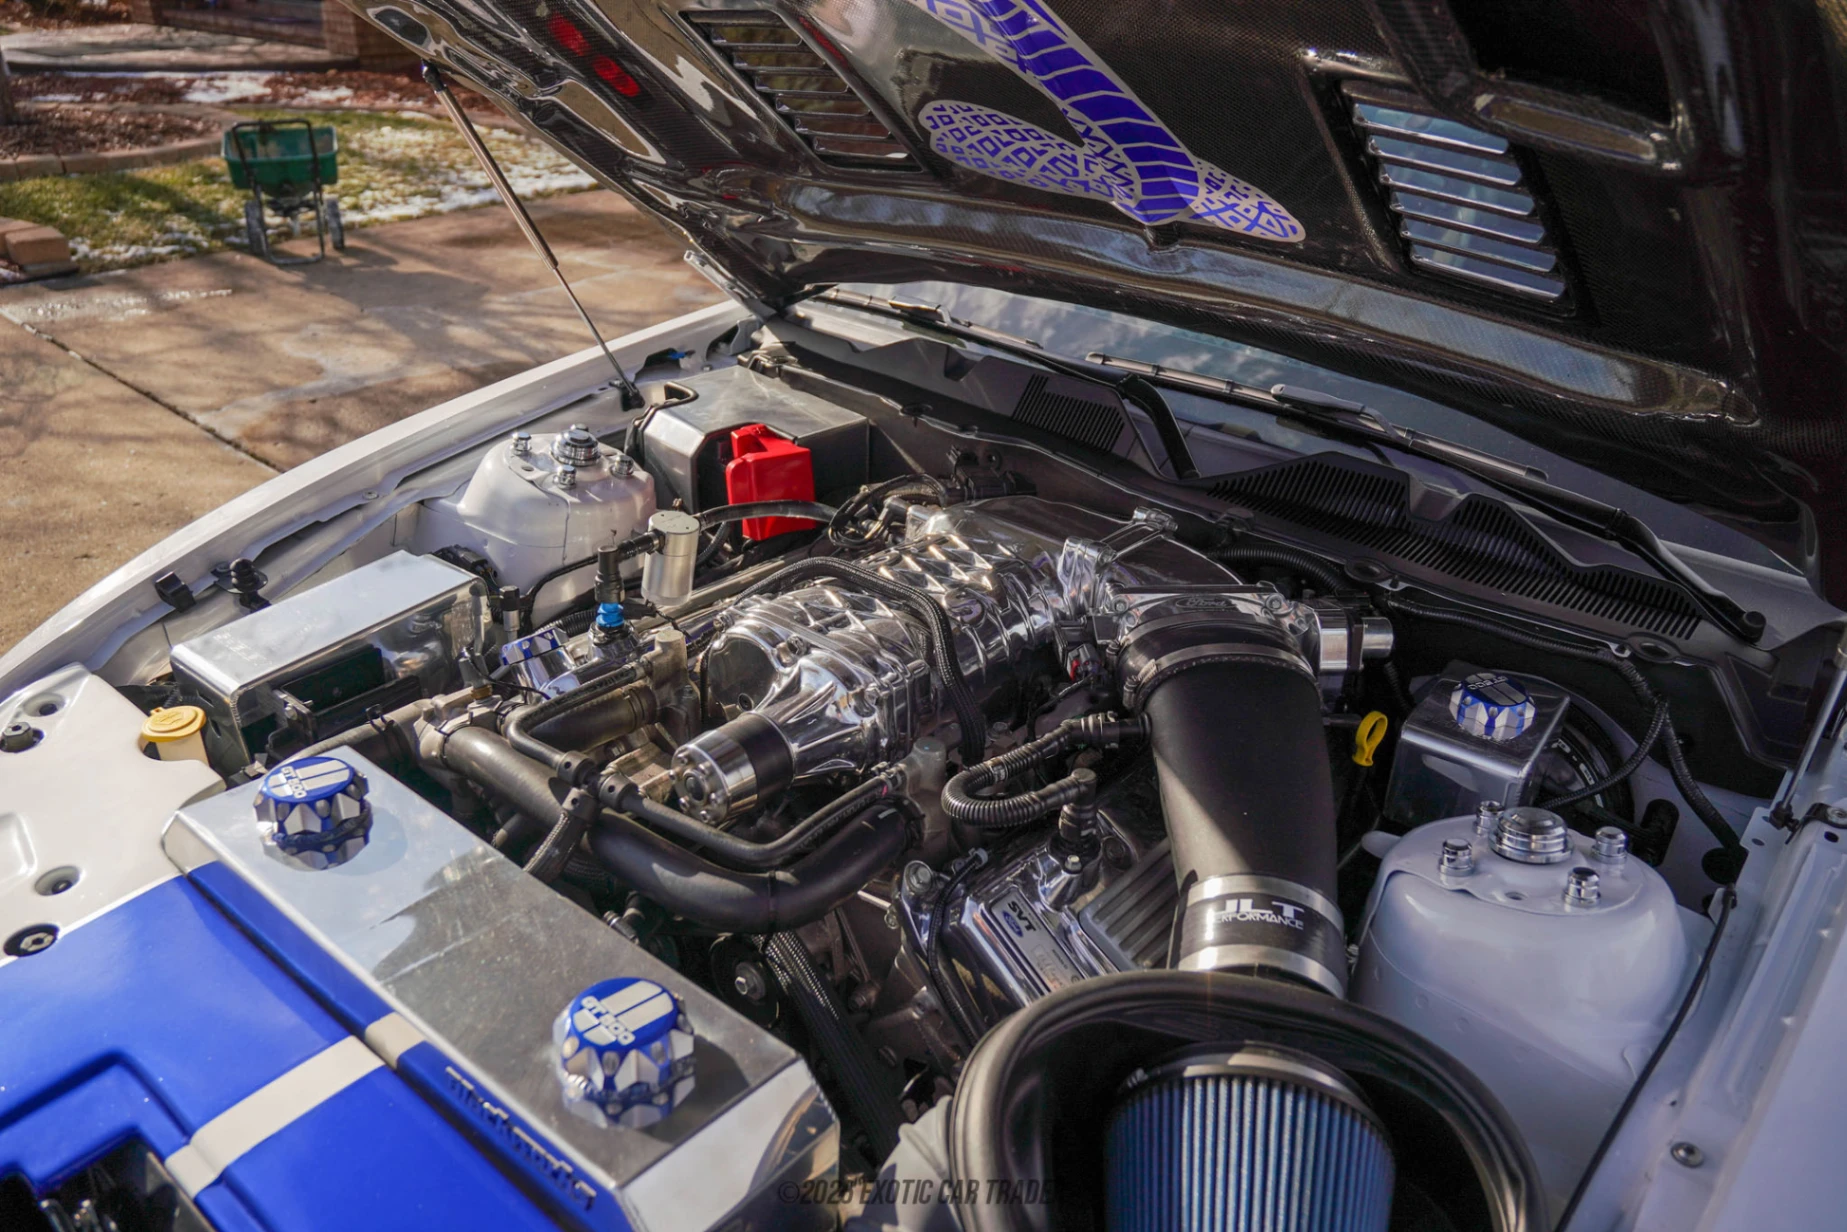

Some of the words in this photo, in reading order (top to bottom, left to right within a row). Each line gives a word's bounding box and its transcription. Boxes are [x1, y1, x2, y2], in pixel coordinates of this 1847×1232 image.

[1007, 900, 1036, 931] SVT
[1216, 898, 1304, 919] JLT
[1211, 910, 1303, 930] ERFORMANCE
